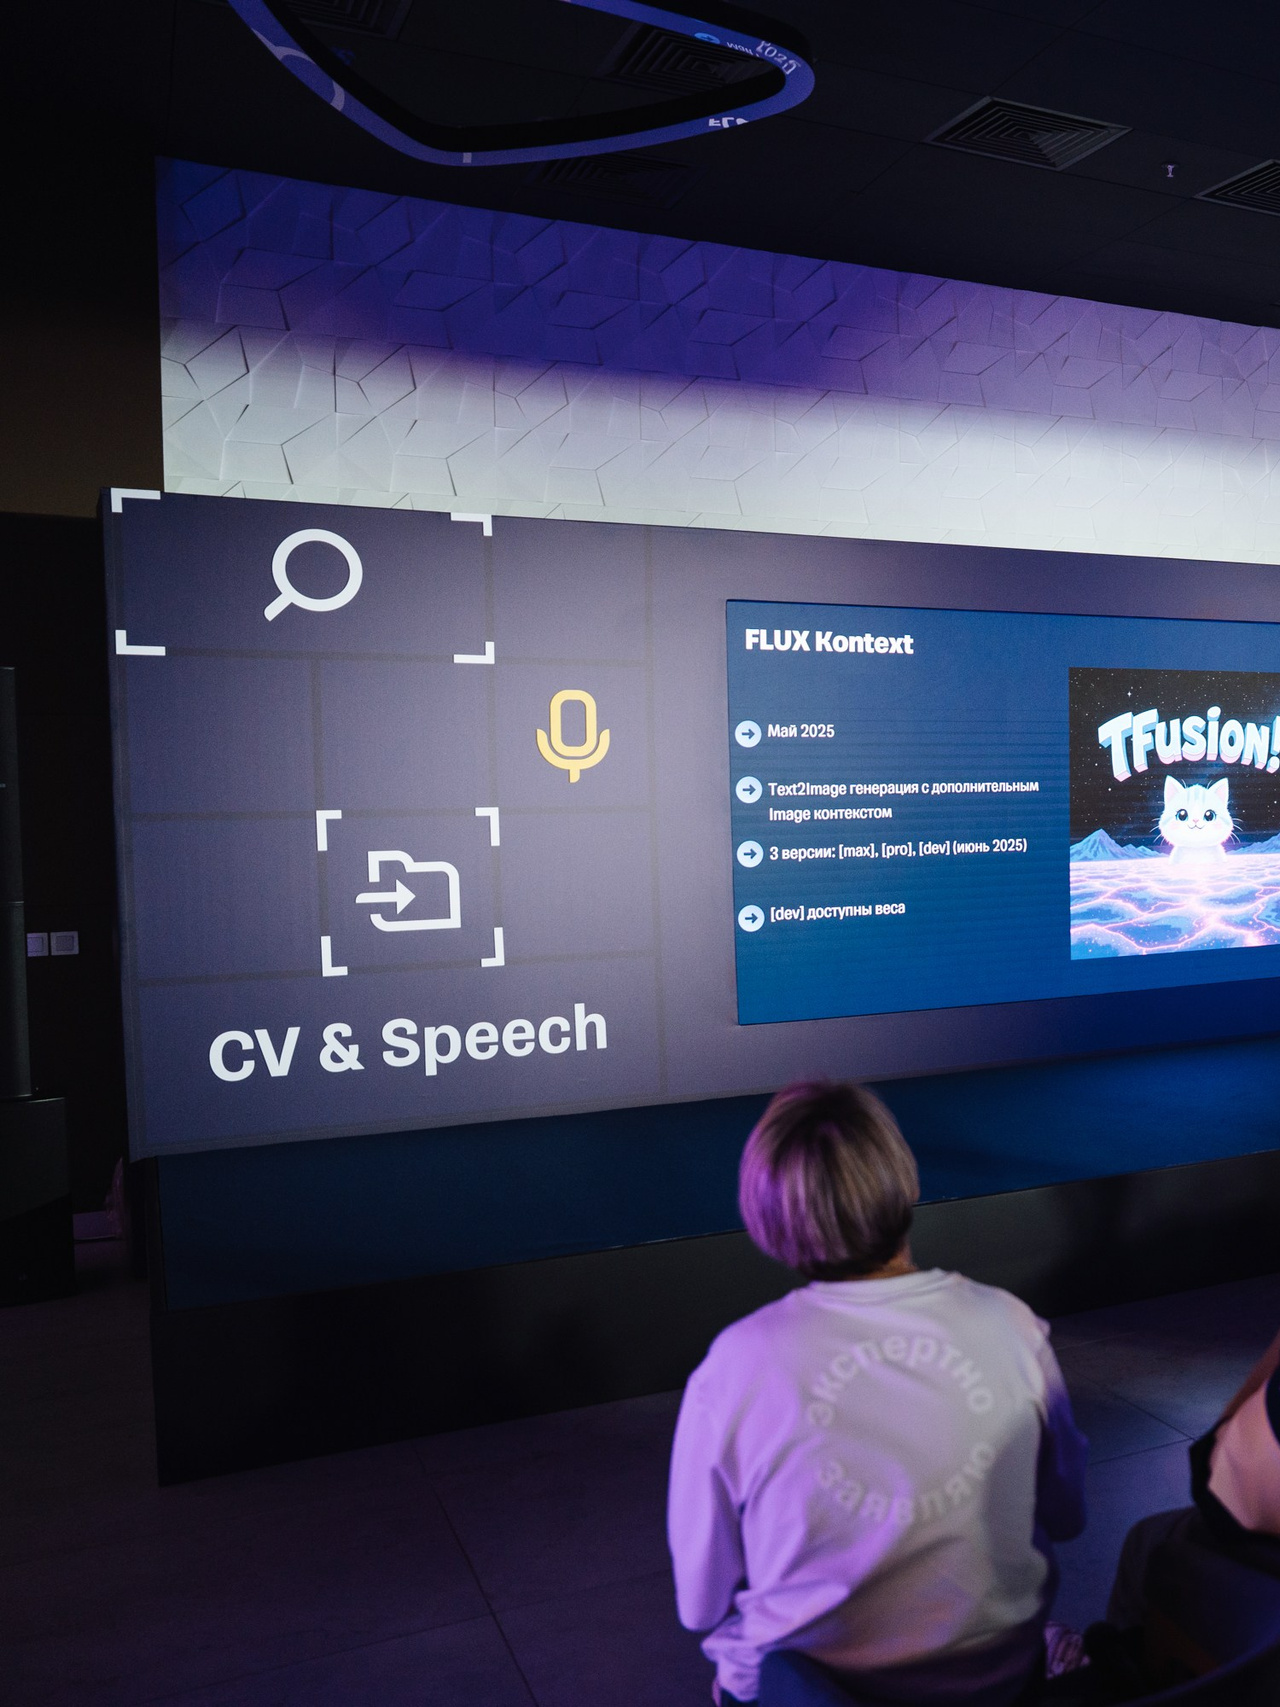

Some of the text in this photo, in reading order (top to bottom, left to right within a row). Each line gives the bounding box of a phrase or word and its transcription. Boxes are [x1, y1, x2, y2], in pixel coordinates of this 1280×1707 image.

[745, 628, 914, 654] FLUX Kontext
[767, 723, 835, 738] Май 2025
[768, 781, 1039, 798] Text2Image генерация с дополнительным
[769, 807, 892, 823] Image контекстом
[769, 838, 1028, 862] 3 версии: [max], [pro], [dev] (июнь 2025)
[770, 902, 906, 922] [dev] доступны веса
[208, 1003, 608, 1082] CV & Speech
